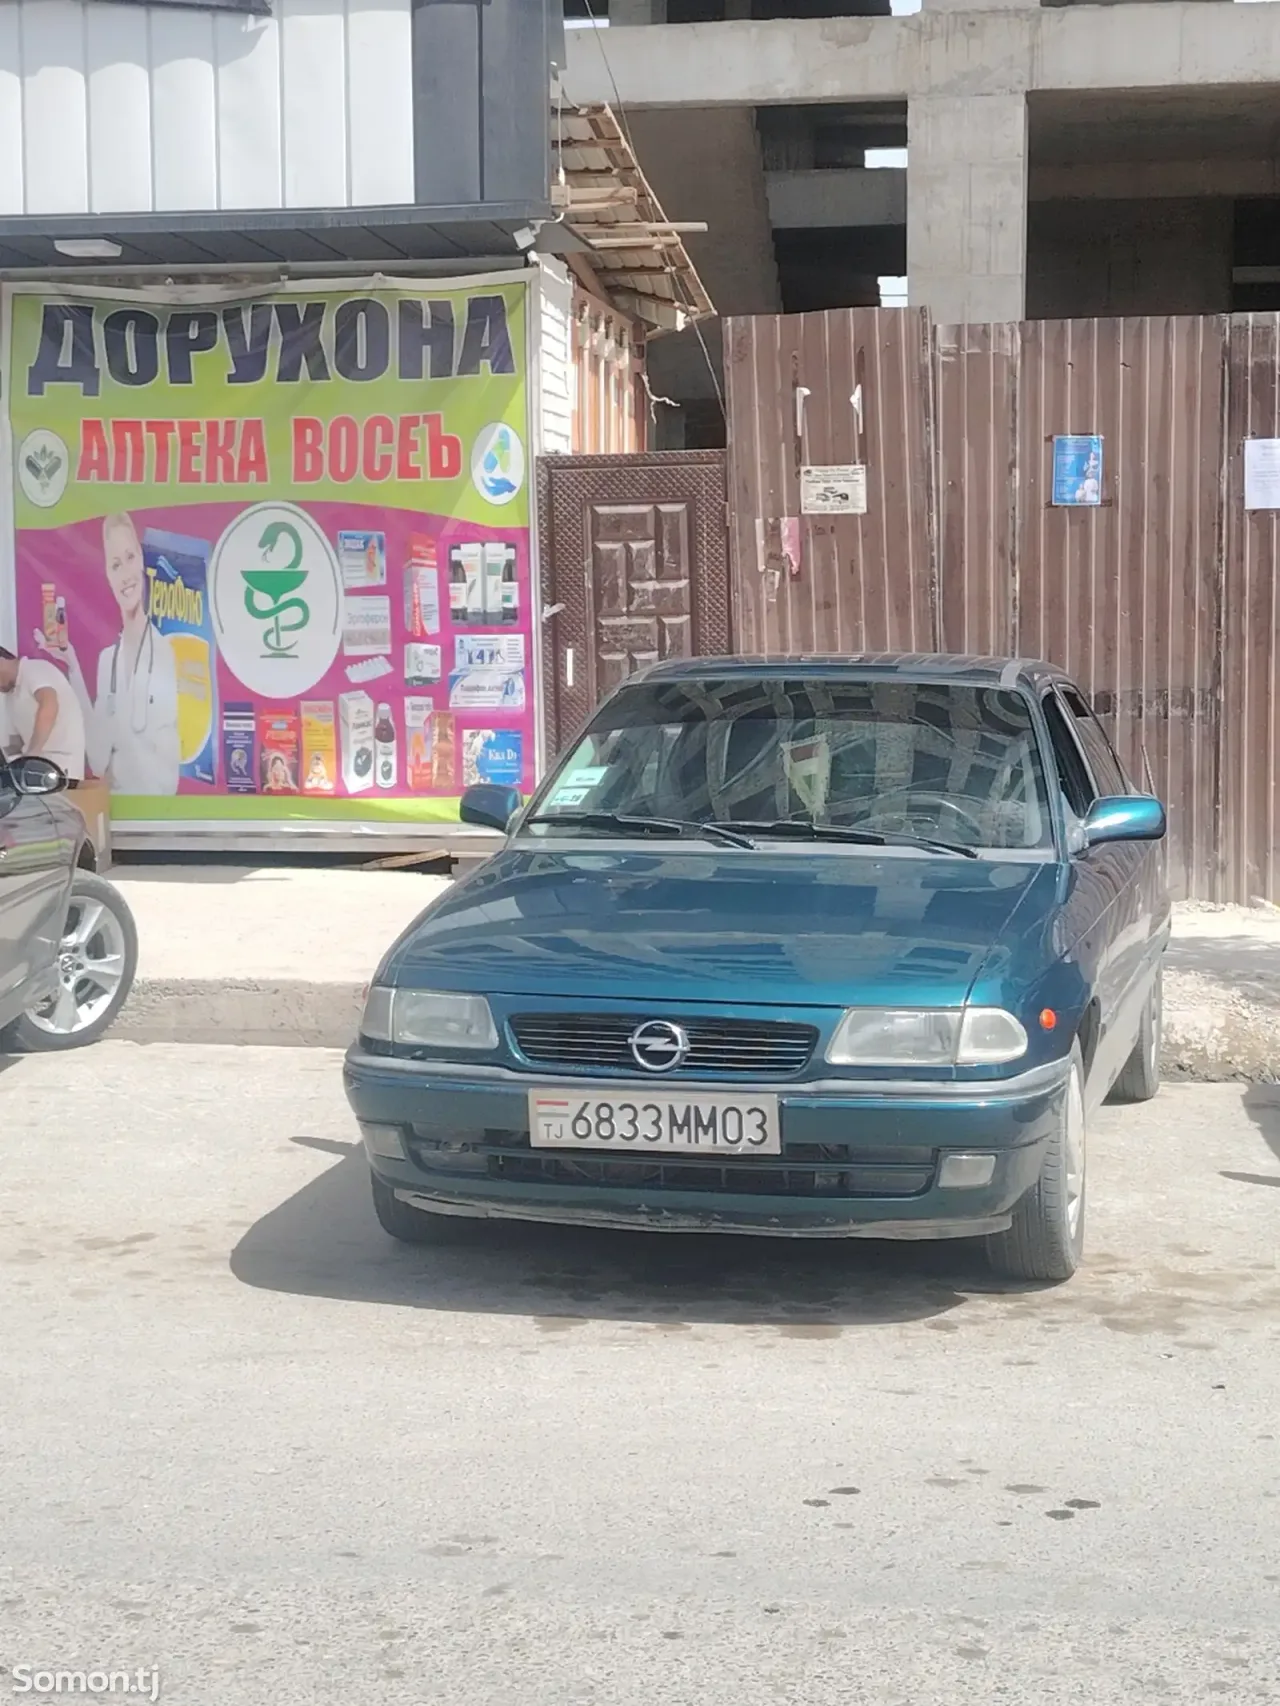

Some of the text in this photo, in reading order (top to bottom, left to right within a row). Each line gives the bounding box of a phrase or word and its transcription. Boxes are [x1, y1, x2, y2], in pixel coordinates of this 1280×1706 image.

[27, 295, 516, 397] ДОРУХОНА
[76, 412, 462, 484] АПТЕКА ВОСЕЪ
[543, 1123, 563, 1139] TJ
[571, 1101, 768, 1146] 6833MM03
